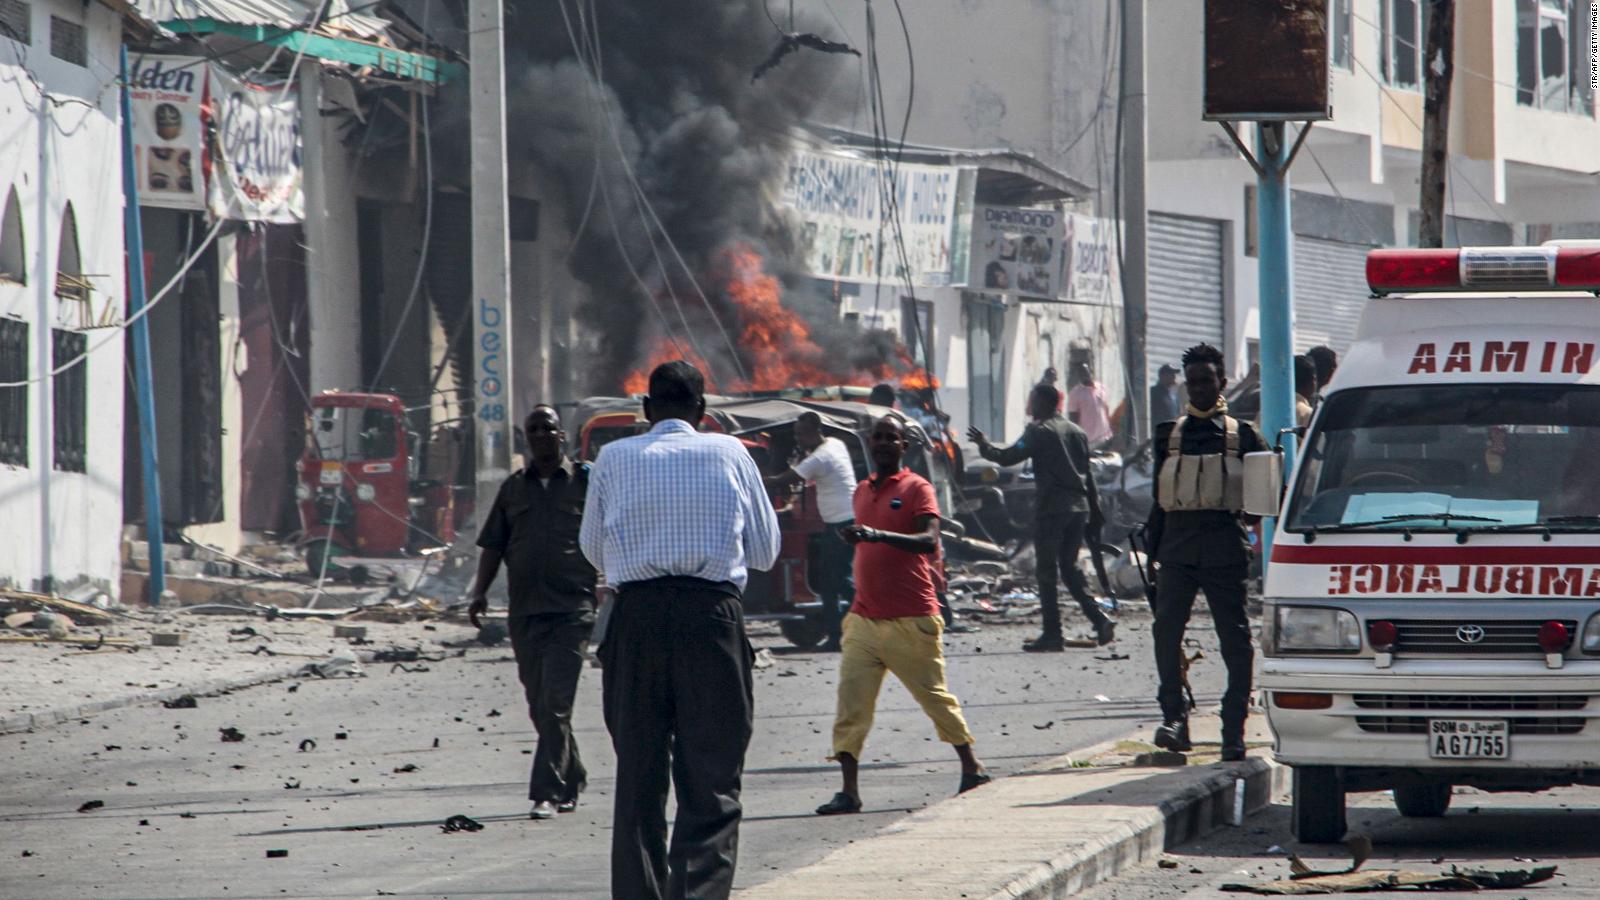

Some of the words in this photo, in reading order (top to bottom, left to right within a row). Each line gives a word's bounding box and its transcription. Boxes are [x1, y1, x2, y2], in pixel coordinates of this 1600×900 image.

[131, 54, 193, 92] lden
[985, 208, 1055, 228] DIAMOND
[481, 299, 501, 397] beco
[1407, 341, 1595, 374] AAMIN
[479, 404, 504, 422] 48
[1432, 722, 1457, 733] SOM
